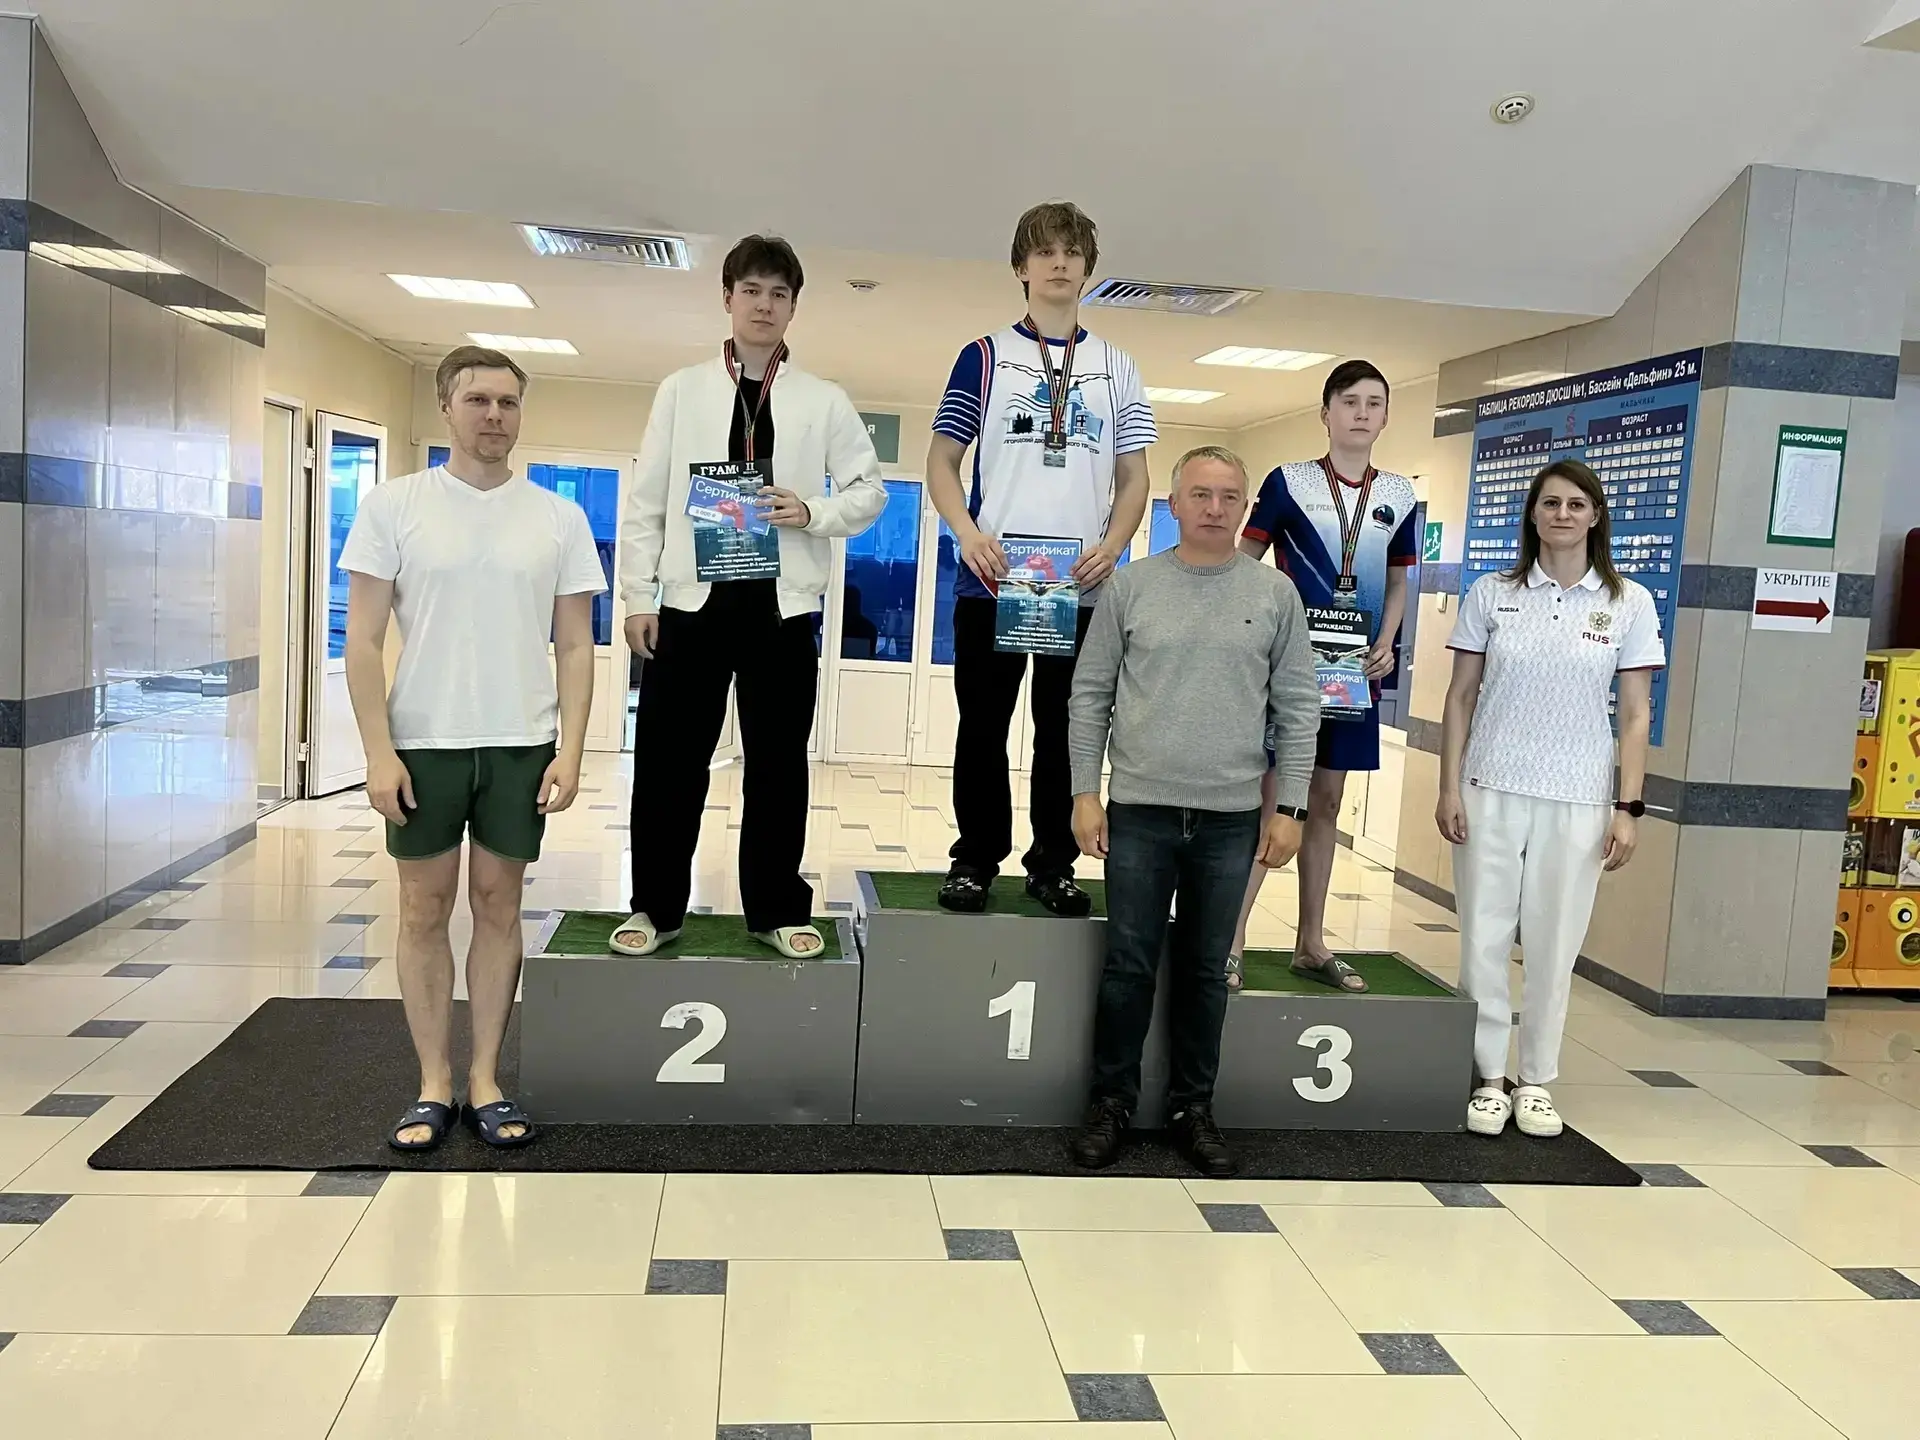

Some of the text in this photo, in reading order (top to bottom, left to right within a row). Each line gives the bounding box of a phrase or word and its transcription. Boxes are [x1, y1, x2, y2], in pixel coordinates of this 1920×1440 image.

[1479, 360, 1697, 416] ТАБЛИЦА РЕКОРДОВ ДЮСШ №1, Бассейн «Дельфин» 25 м.
[1621, 413, 1649, 426] ВОЗРАСТ
[1503, 434, 1524, 444] ВОЗРАСТ
[1782, 432, 1843, 445] ИНФОРМАЦИЯ
[700, 464, 740, 475] ГРАМ
[745, 462, 755, 471] II
[1001, 542, 1077, 557] Сертификат
[1340, 577, 1352, 586] III
[1764, 572, 1830, 588] УКРЫТИЕ
[1306, 608, 1363, 622] ГРАМОТА
[1314, 622, 1353, 632] НАГРАЖДАЕТСЯ
[1582, 631, 1610, 645] RUS
[988, 980, 1036, 1060] 1
[655, 1001, 727, 1083] 2
[1291, 1024, 1353, 1103] 3
